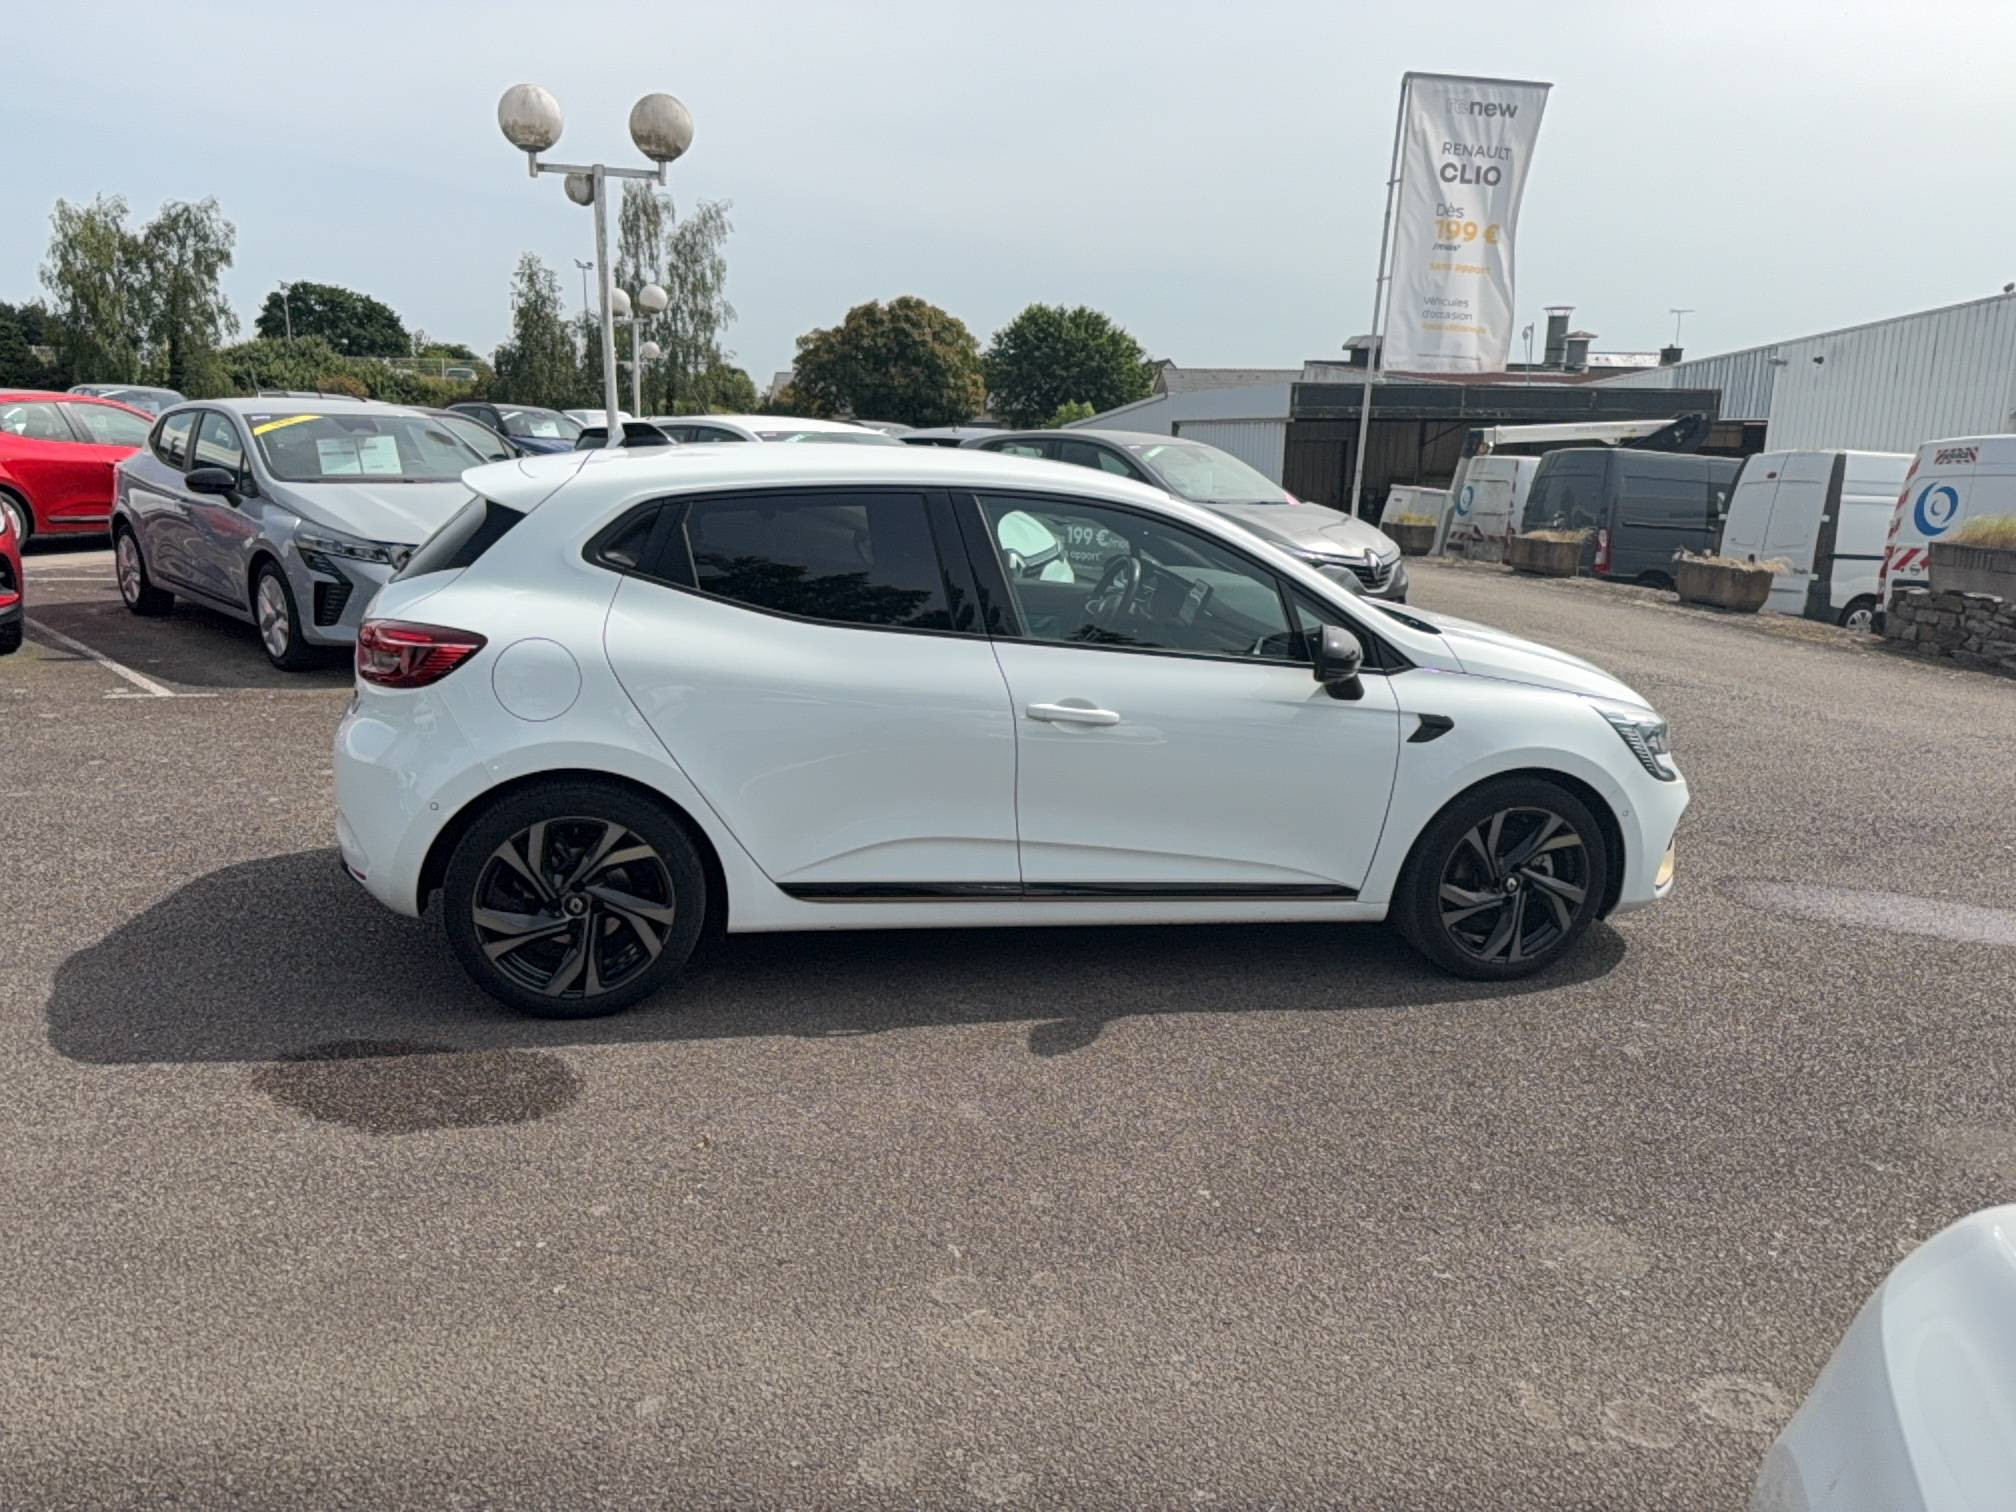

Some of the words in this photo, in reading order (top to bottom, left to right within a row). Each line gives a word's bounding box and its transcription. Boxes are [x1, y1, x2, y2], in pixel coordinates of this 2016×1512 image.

[1441, 141, 1513, 161] RENAULT
[1439, 162, 1503, 187] CLIO
[1436, 201, 1465, 219] Dès
[1434, 219, 1479, 243] 199
[1483, 222, 1501, 246] €
[1067, 525, 1094, 545] 199
